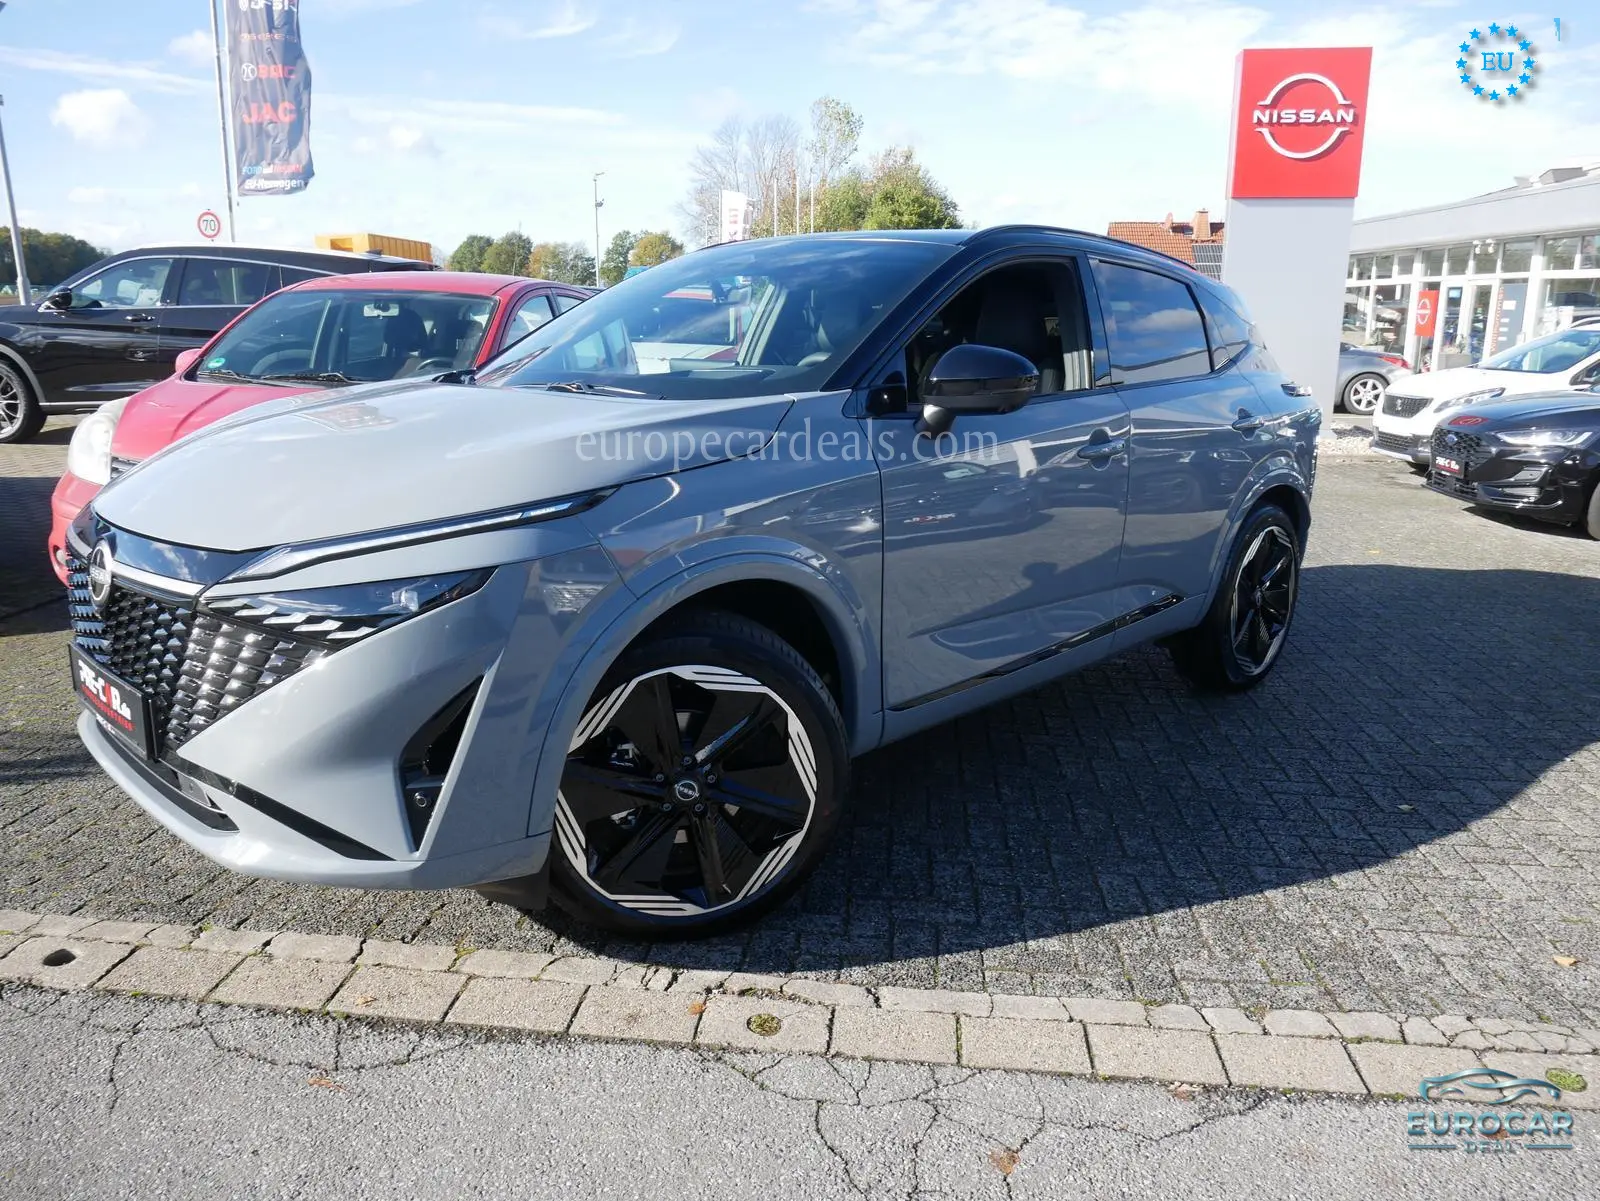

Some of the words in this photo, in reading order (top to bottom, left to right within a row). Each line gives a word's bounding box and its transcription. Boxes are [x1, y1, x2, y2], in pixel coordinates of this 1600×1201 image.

[242, 101, 297, 124] JAC
[1252, 107, 1355, 124] NISSAN
[202, 219, 216, 232] 70
